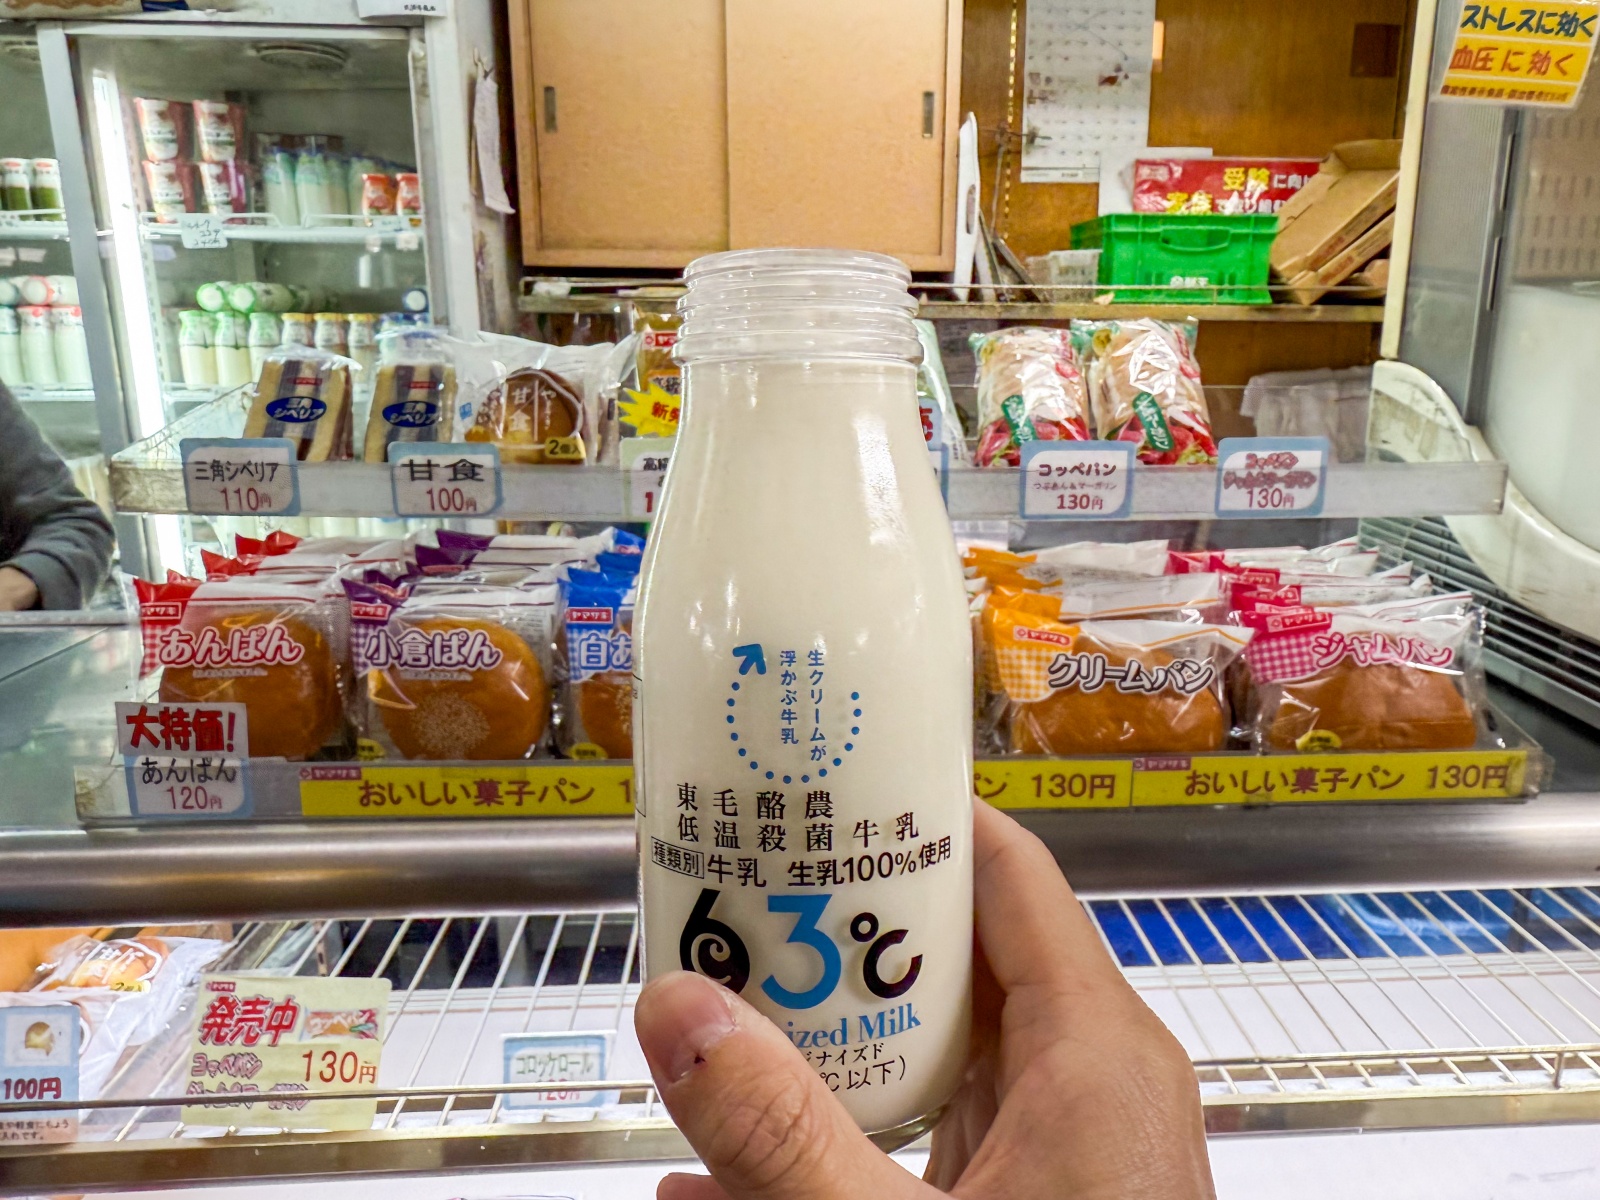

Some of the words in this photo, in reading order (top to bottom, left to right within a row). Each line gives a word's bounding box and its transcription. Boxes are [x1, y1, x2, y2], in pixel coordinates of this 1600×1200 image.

[1460, 4, 1598, 38] ストレスに効く
[1449, 45, 1574, 77] 血圧に効く
[194, 459, 280, 482] 三角シベリア
[400, 458, 485, 482] 甘食
[1038, 462, 1117, 477] コッペパン
[220, 487, 272, 512] 110円
[426, 487, 478, 512] 100円
[1056, 493, 1104, 510] 130円
[1246, 487, 1295, 508] 130円
[159, 627, 304, 666] あんぱん
[366, 629, 502, 670] 小倉ぱん
[1312, 632, 1454, 668] ジャムパン
[1048, 652, 1216, 694] クリームパン
[779, 650, 799, 745] 浮かぶ牛乳
[807, 649, 827, 762] 生クリームが
[126, 705, 237, 752] 大特価!
[358, 777, 595, 808] おいしい菓子パン
[1031, 774, 1116, 800] 130円
[1184, 765, 1406, 796] おいしい菓子パン
[1426, 763, 1511, 789] 130円
[166, 785, 223, 810] 120円
[676, 782, 834, 820] 東毛酪農
[652, 840, 701, 876] 種類別
[707, 853, 767, 888] 牛乳
[786, 835, 951, 888] 生乳100%使用
[199, 994, 301, 1047] 発売中
[858, 1002, 921, 1042] Milk
[302, 1049, 378, 1084] 130円
[3, 1076, 63, 1100] 100円
